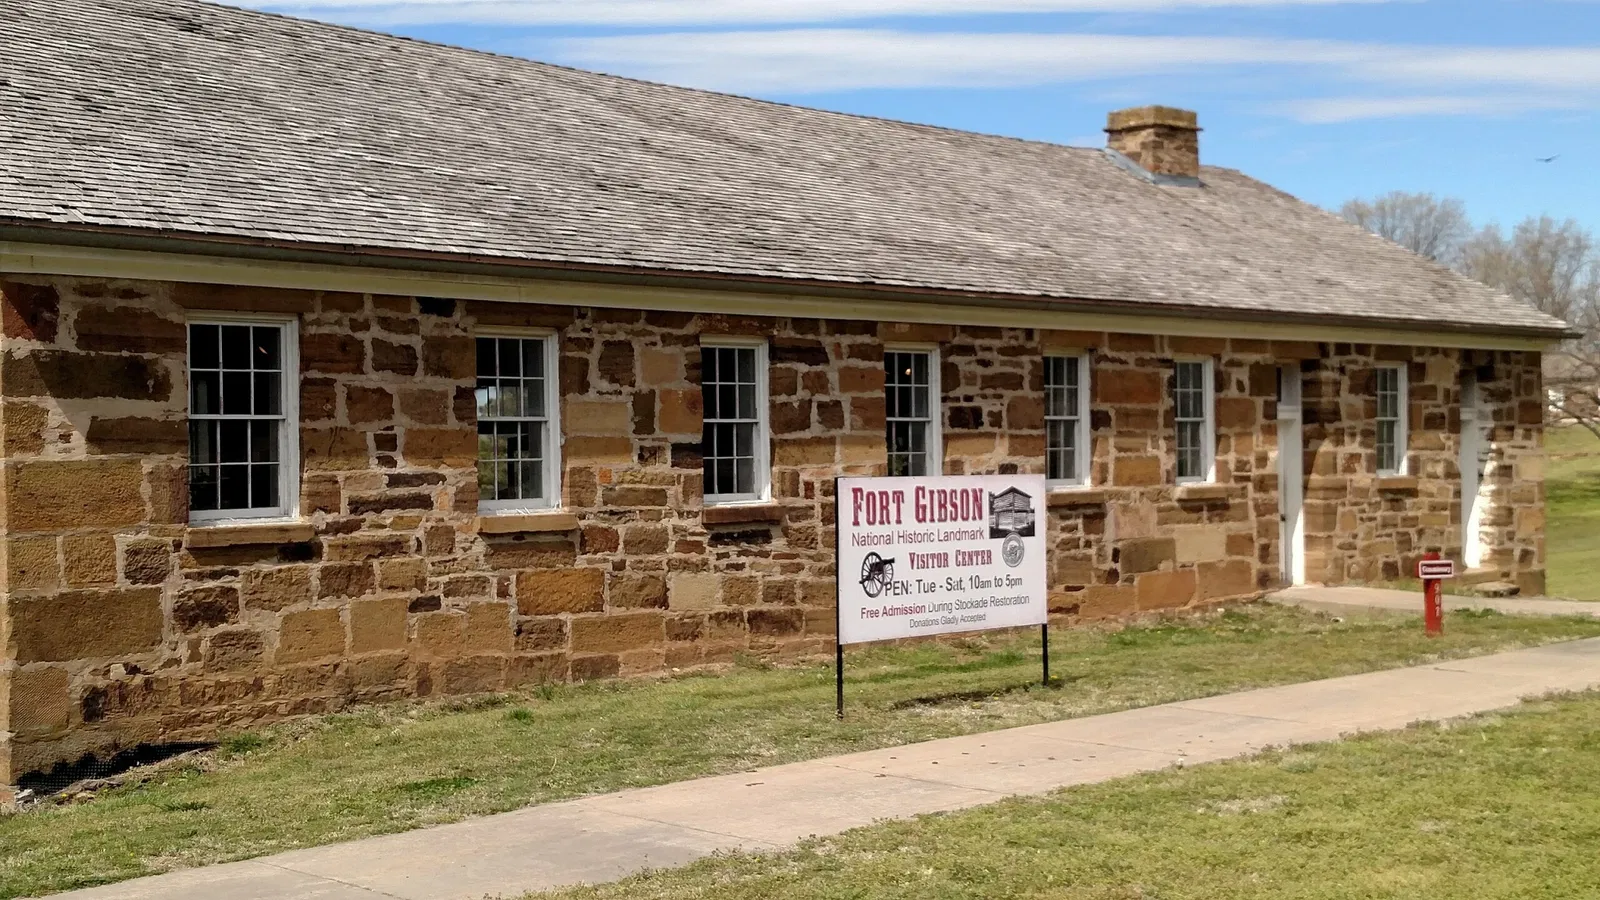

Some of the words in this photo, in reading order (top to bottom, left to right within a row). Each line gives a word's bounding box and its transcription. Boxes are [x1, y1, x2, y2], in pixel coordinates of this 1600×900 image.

[851, 487, 904, 526] FORT
[915, 485, 984, 523] GIBSON
[852, 529, 894, 547] National
[897, 529, 935, 545] Historic
[938, 527, 985, 542] Landmark
[909, 551, 949, 570] VISITOR
[955, 549, 992, 567] CENTER
[916, 579, 936, 594] Tue
[945, 576, 966, 593] Sat,
[968, 574, 992, 590] 10am
[994, 575, 1003, 588] to
[1005, 573, 1023, 589] 5pm
[861, 607, 880, 619] Free
[881, 603, 926, 618] Admission
[928, 601, 953, 614] During
[954, 596, 988, 611] Stockade
[989, 594, 1030, 608] Restoration
[909, 617, 940, 629] Donations
[940, 614, 959, 627] Gladly
[960, 612, 987, 625] Accepted
